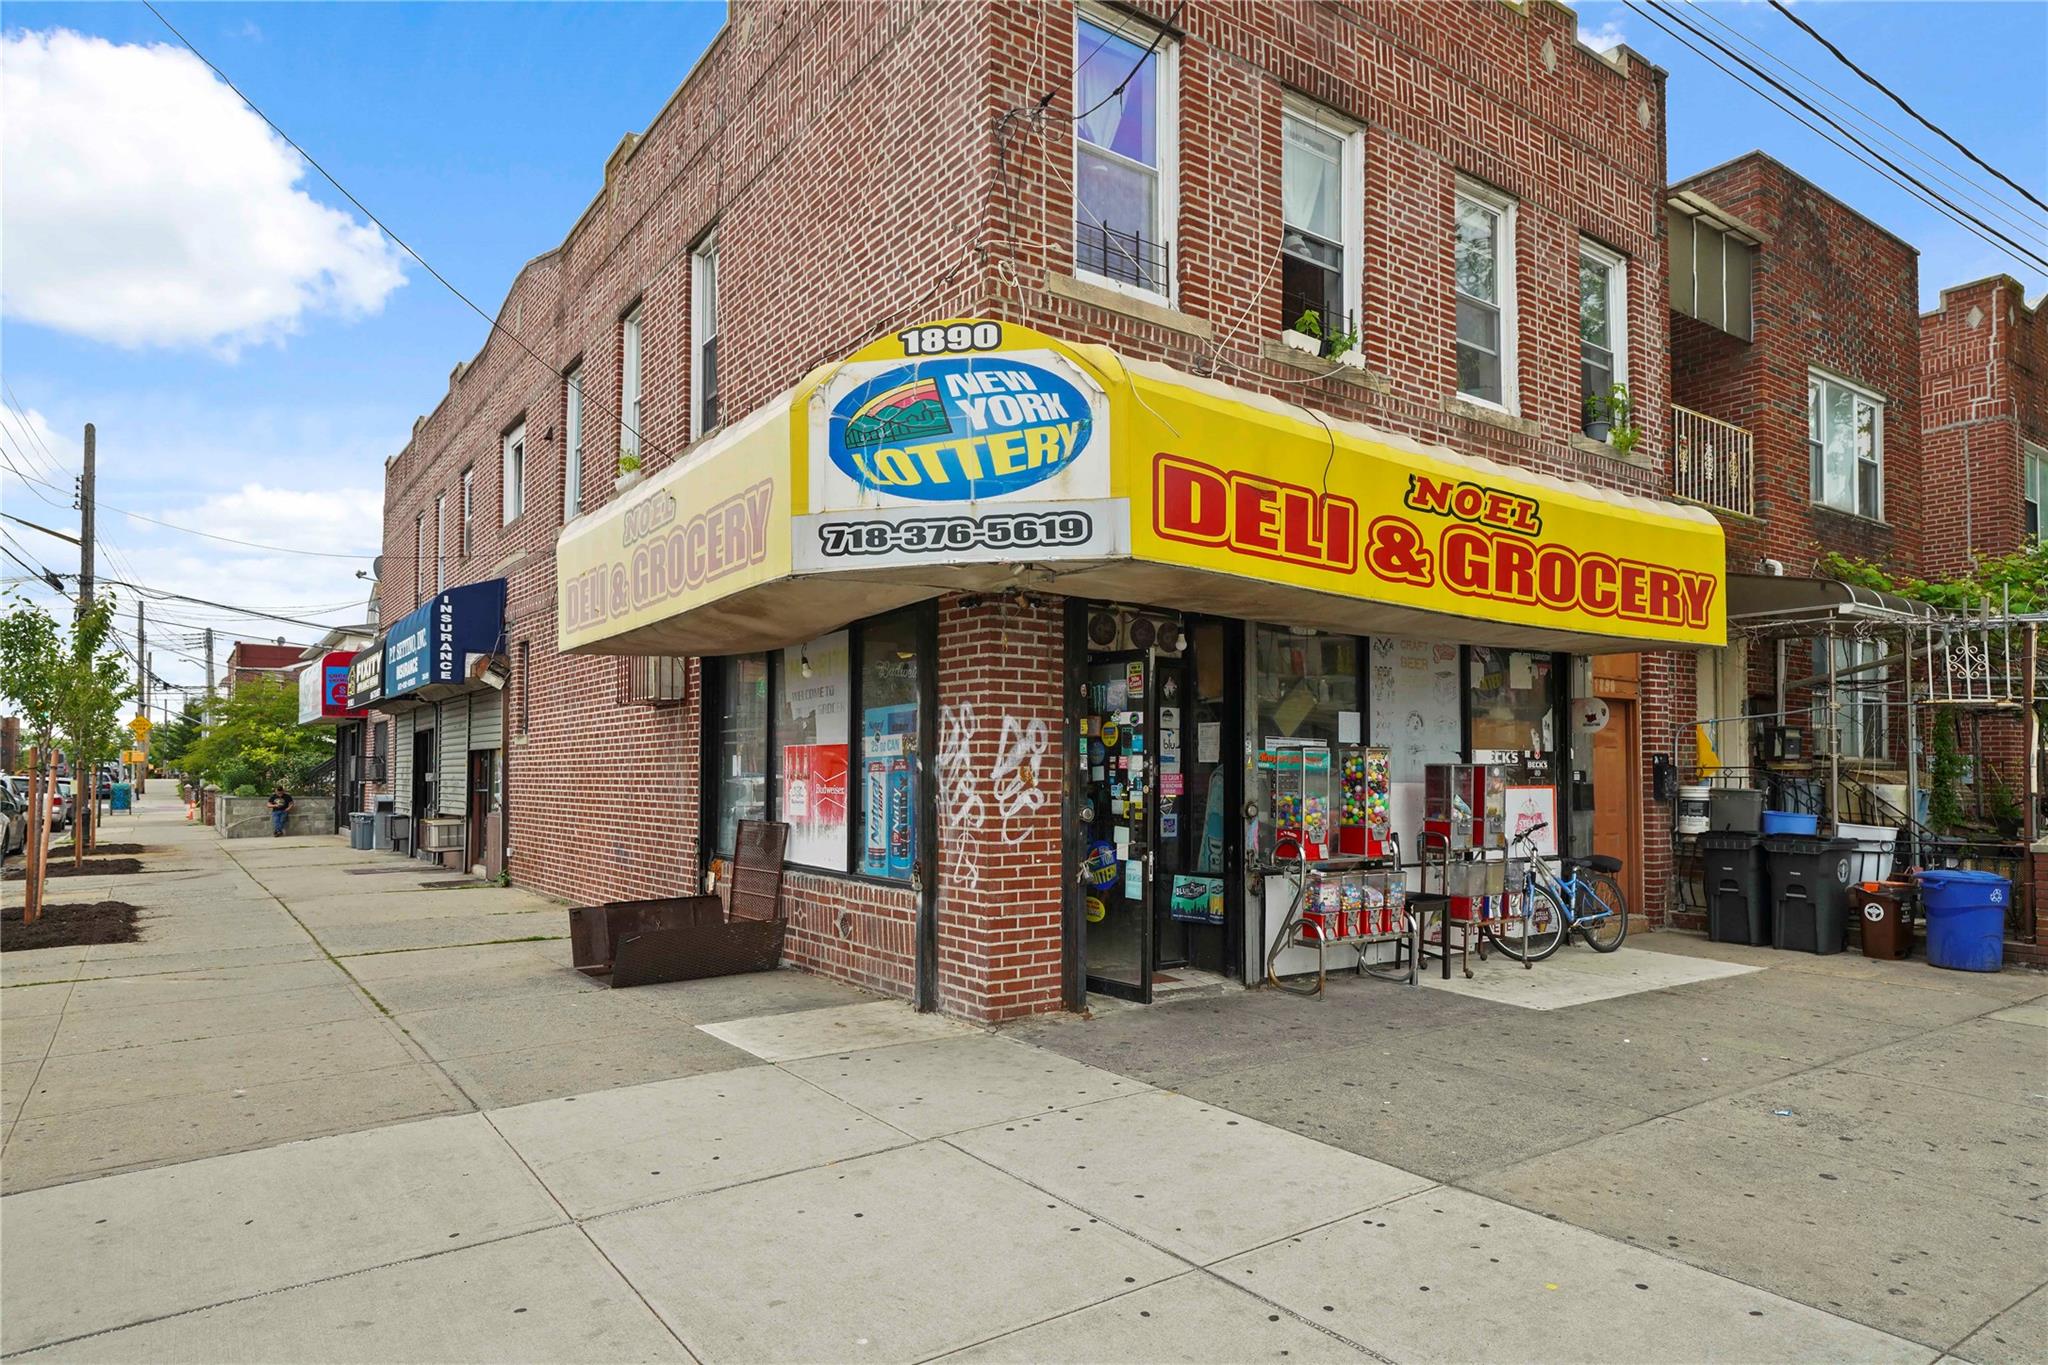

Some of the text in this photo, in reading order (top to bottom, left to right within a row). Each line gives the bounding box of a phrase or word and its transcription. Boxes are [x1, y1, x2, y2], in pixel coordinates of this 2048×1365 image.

[900, 323, 1001, 355] 1890
[947, 370, 1037, 399] NEW
[957, 391, 1069, 430] YORK
[850, 421, 1079, 487] LOTTERY
[623, 490, 676, 546] NOEL
[1408, 474, 1540, 533] NOEL
[822, 513, 1091, 555] 718-376-5619
[1158, 458, 1713, 625] DELI & GROCERY
[567, 480, 772, 632] DELI & GROCERY
[440, 595, 453, 680] INSURANCE
[1401, 656, 1429, 671] BEER
[792, 686, 825, 701] WELCOME
[1163, 738, 1176, 750] blu
[1527, 760, 1548, 769] BECK'S
[815, 783, 845, 795] Budweiser
[871, 775, 880, 846] Natural
